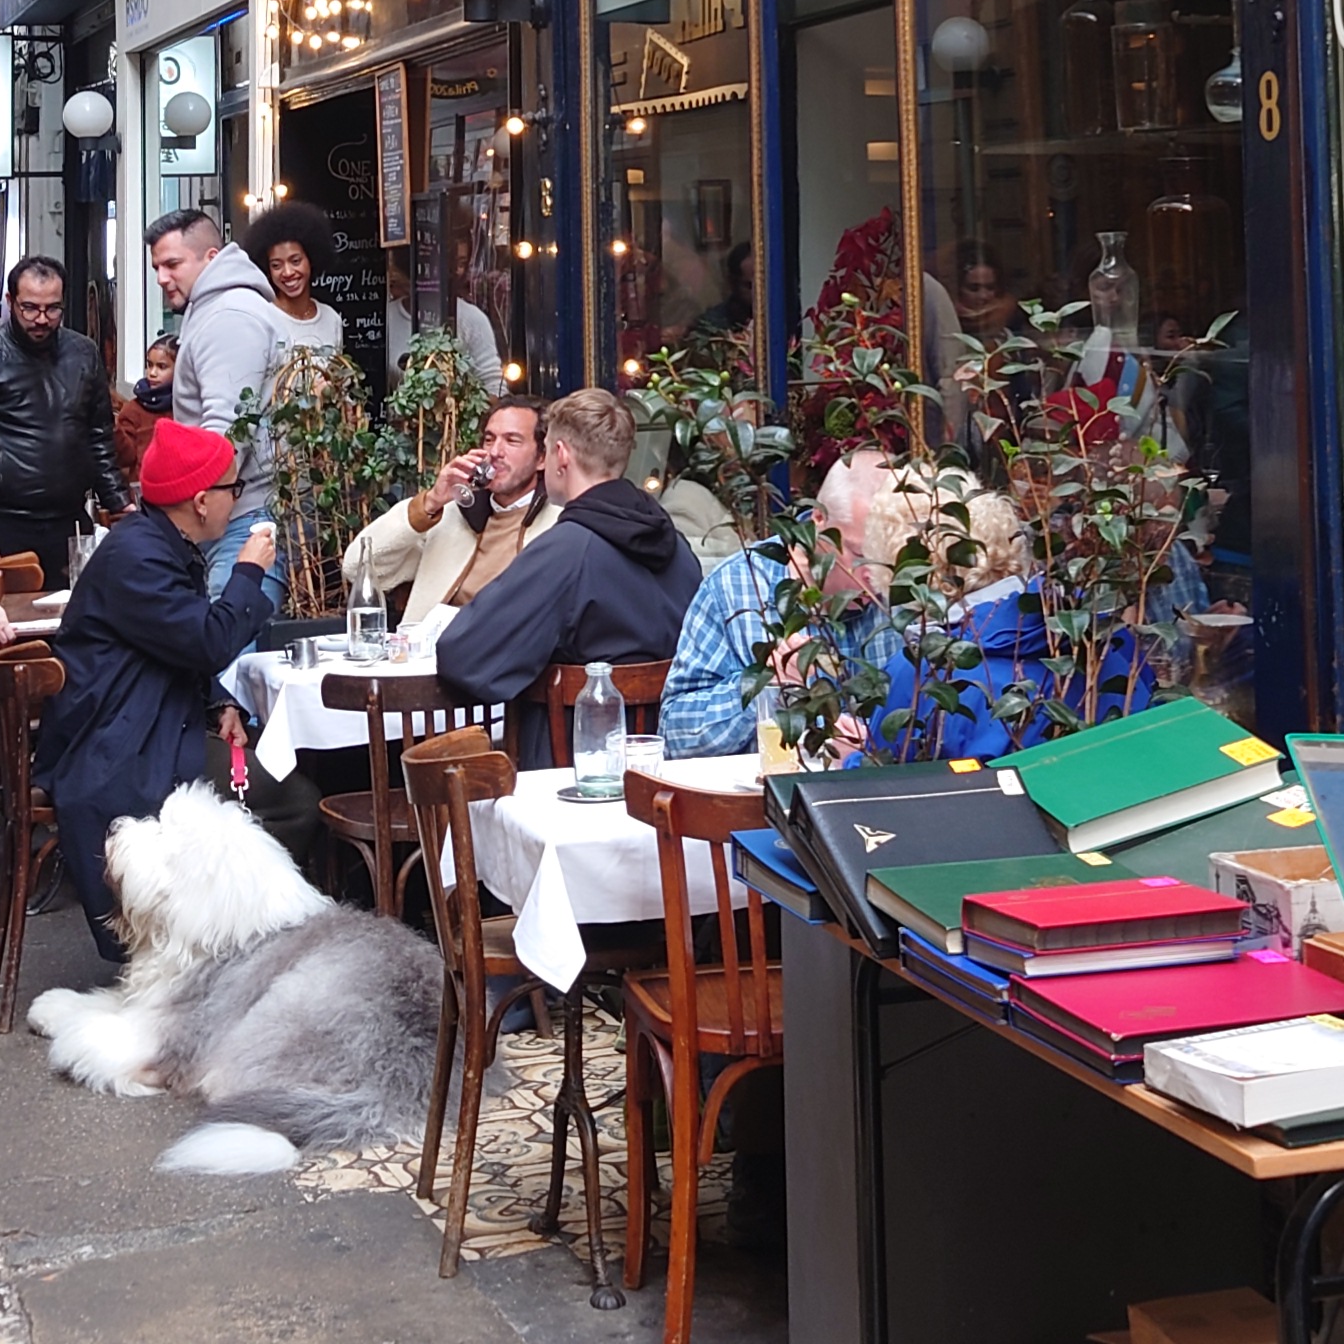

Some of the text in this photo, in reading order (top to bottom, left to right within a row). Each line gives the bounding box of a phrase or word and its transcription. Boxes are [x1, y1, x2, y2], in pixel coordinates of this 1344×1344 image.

[1258, 70, 1281, 141] 8
[338, 158, 371, 177] ONE
[361, 269, 386, 287] Hou
